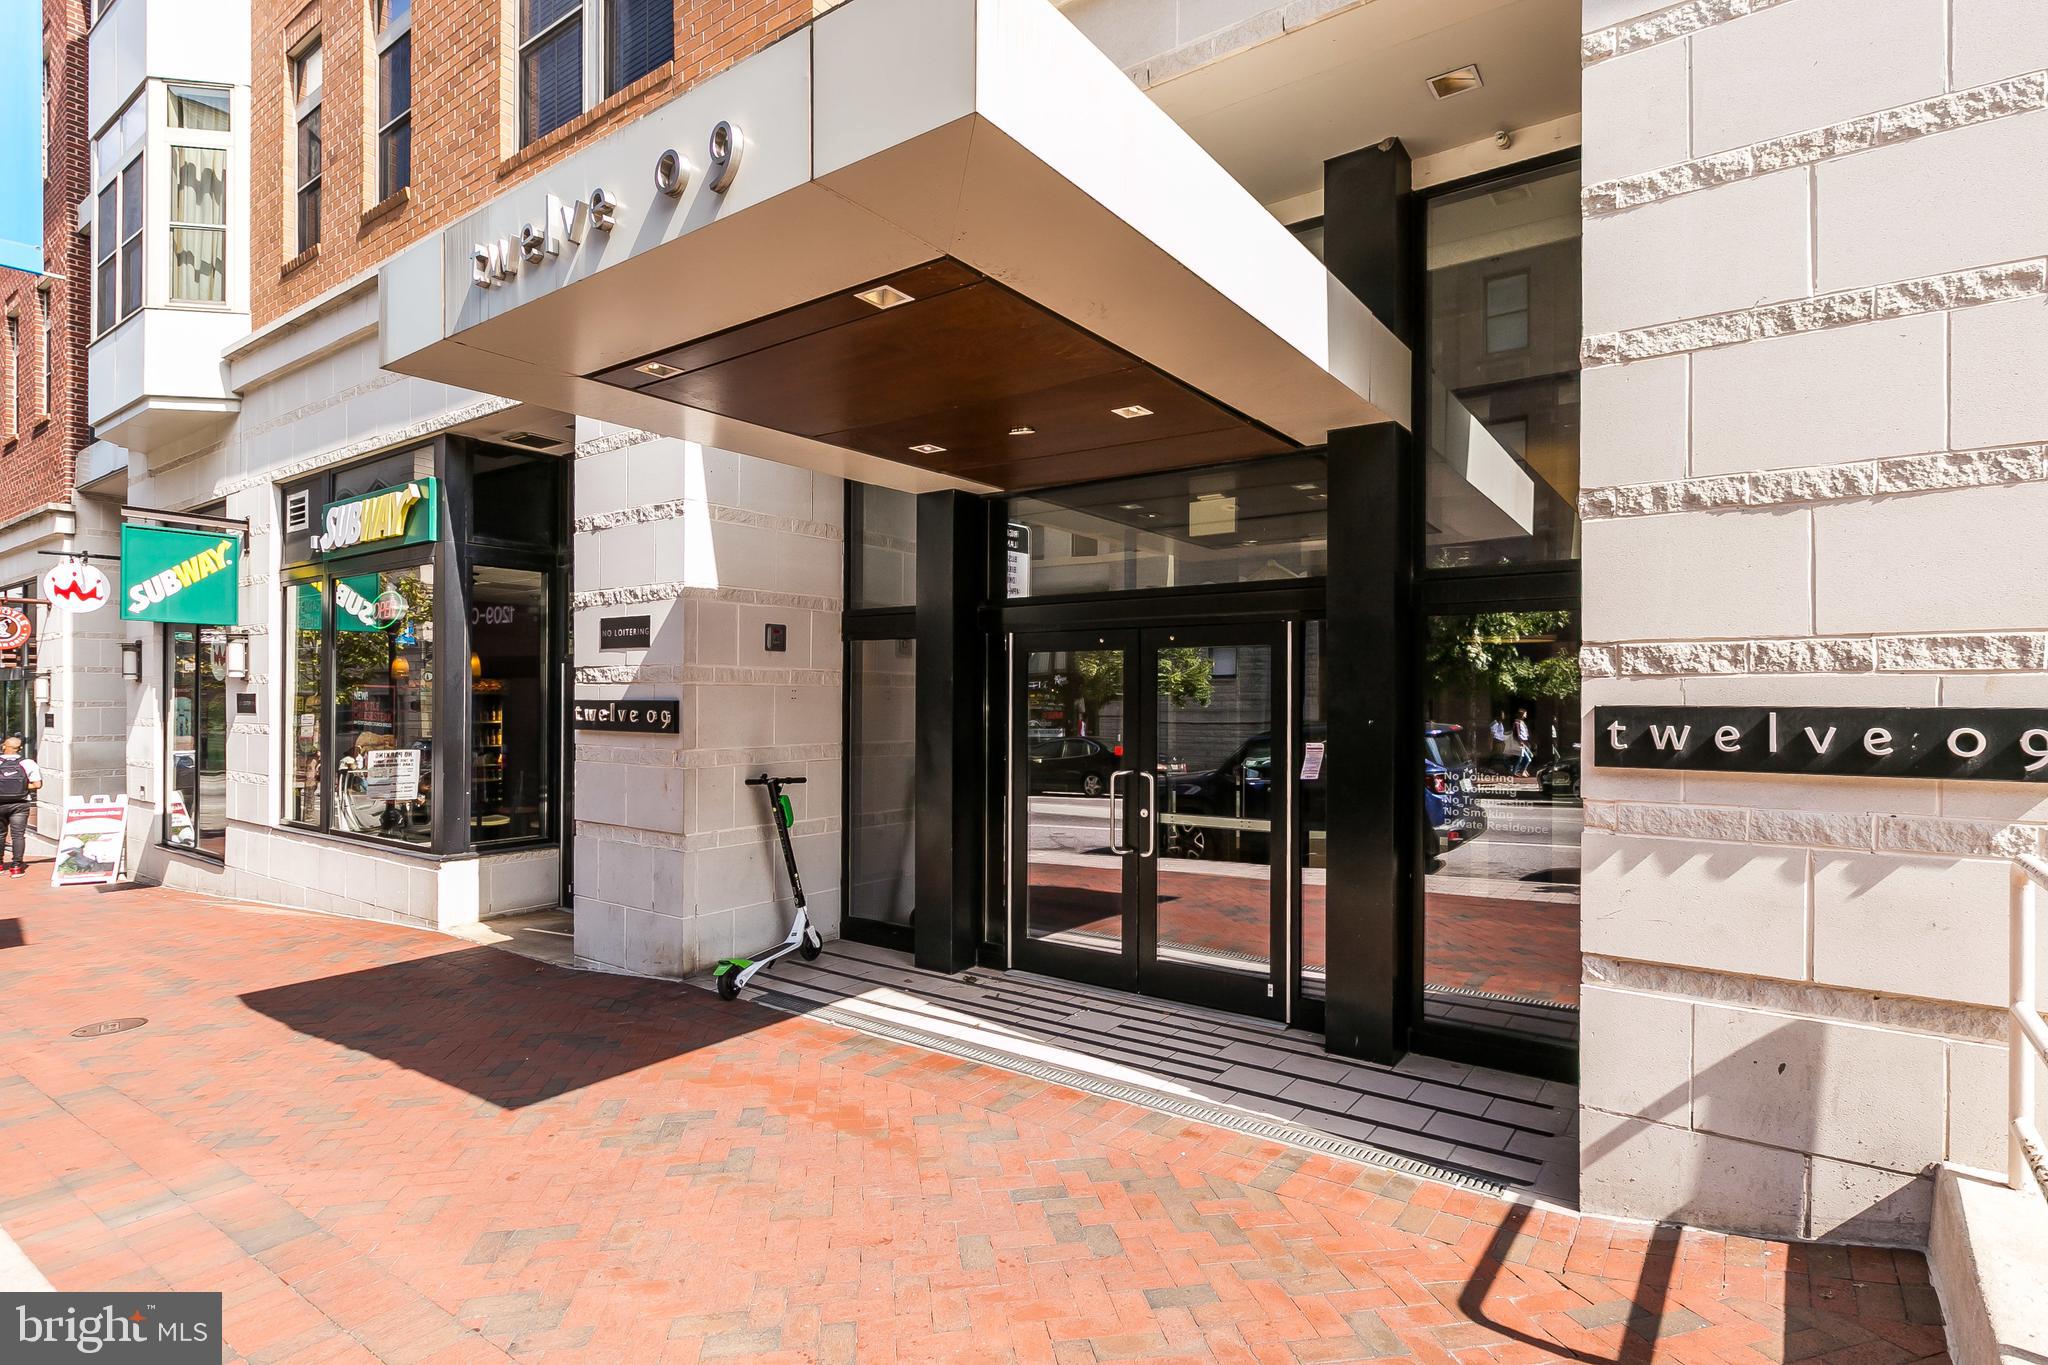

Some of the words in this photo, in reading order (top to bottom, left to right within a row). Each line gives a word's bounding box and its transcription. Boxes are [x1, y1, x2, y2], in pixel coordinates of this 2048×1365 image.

[470, 187, 617, 289] twelve
[320, 483, 421, 552] SUBWAY
[128, 540, 232, 613] SUBWAY
[602, 629, 612, 637] NO
[614, 627, 650, 637] LOITERING
[575, 702, 639, 722] twelve
[1607, 712, 1894, 757] twelve
[1443, 771, 1460, 781] No
[1463, 772, 1514, 784] Loitering
[1443, 783, 1460, 793] No
[1443, 795, 1460, 805] No
[1443, 806, 1460, 816] No
[1463, 807, 1514, 820] Smoking
[1443, 818, 1483, 830] Private
[1487, 821, 1549, 834] Residence
